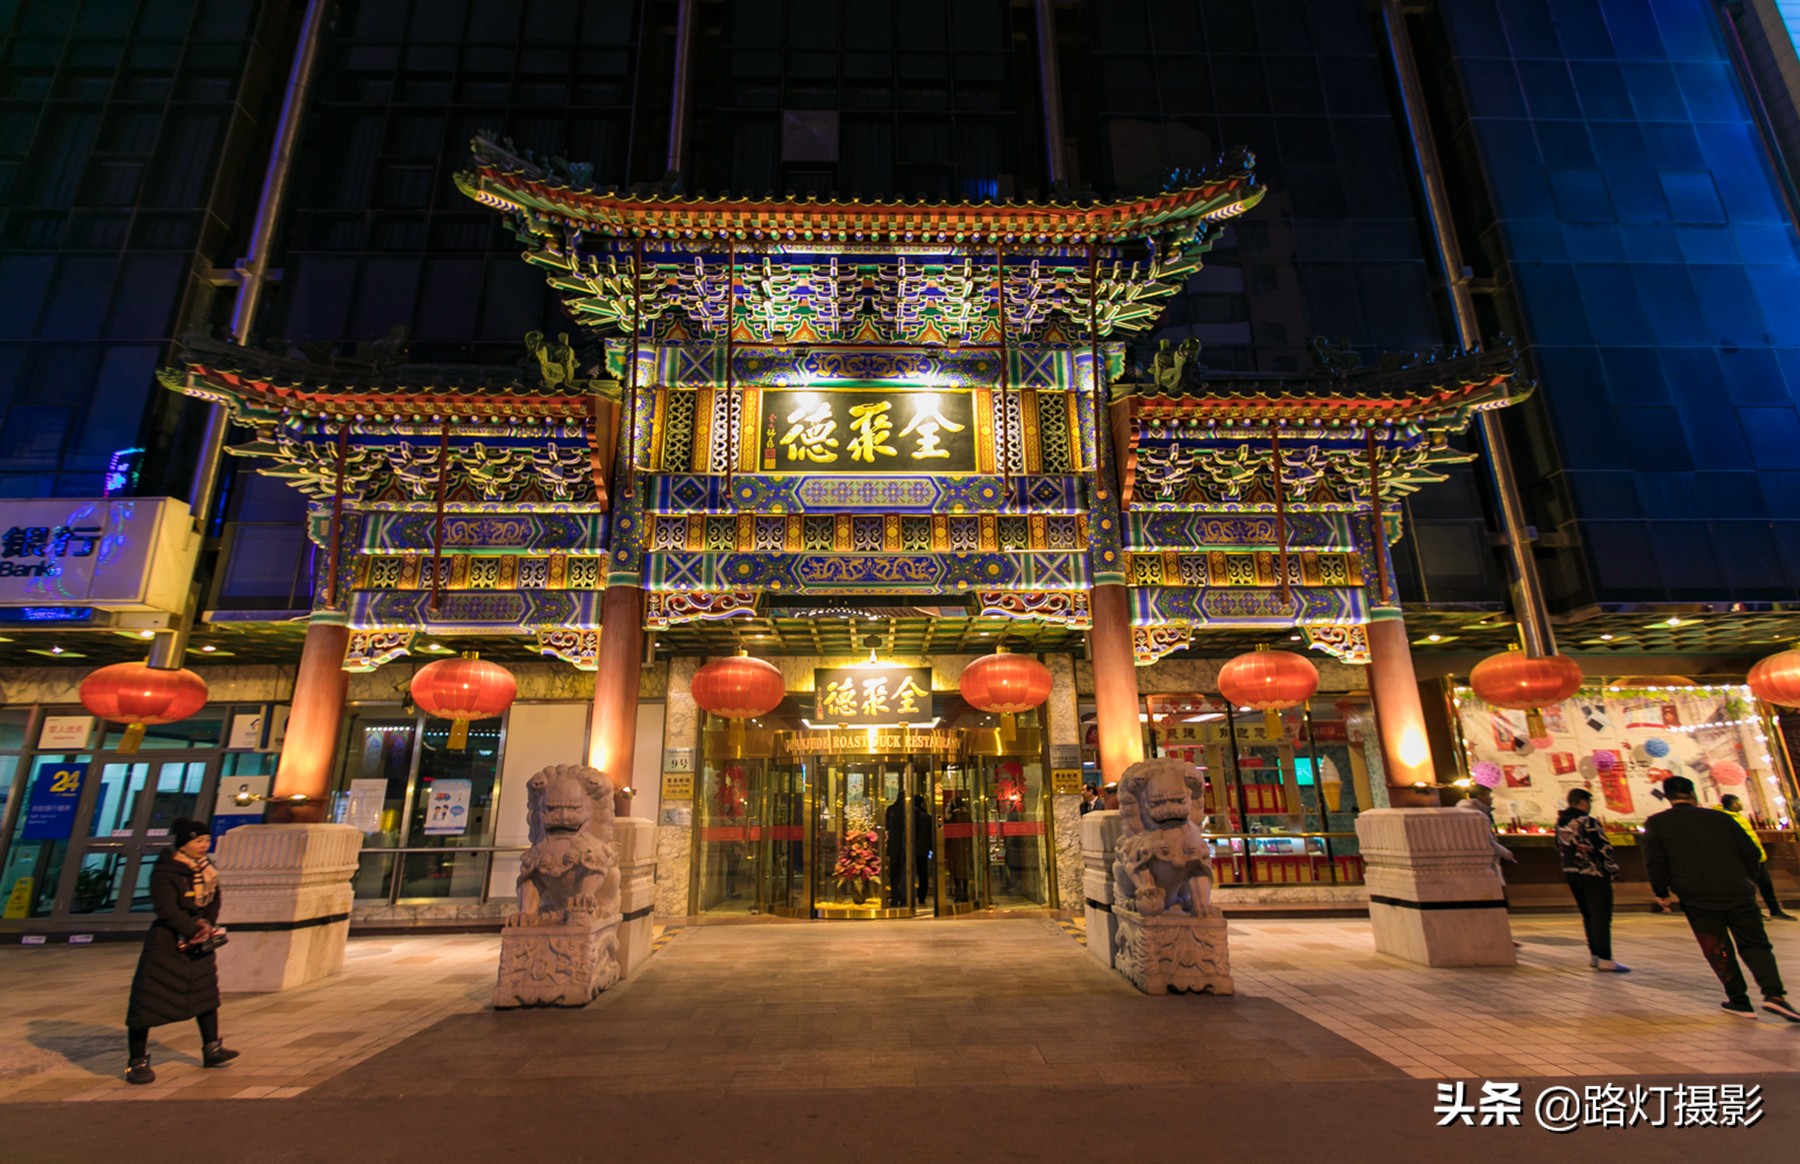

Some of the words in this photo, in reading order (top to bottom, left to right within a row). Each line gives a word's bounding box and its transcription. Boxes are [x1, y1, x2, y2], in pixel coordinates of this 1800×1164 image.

[0, 560, 55, 577] Bank
[832, 735, 867, 749] ROAST
[49, 770, 81, 792] 24
